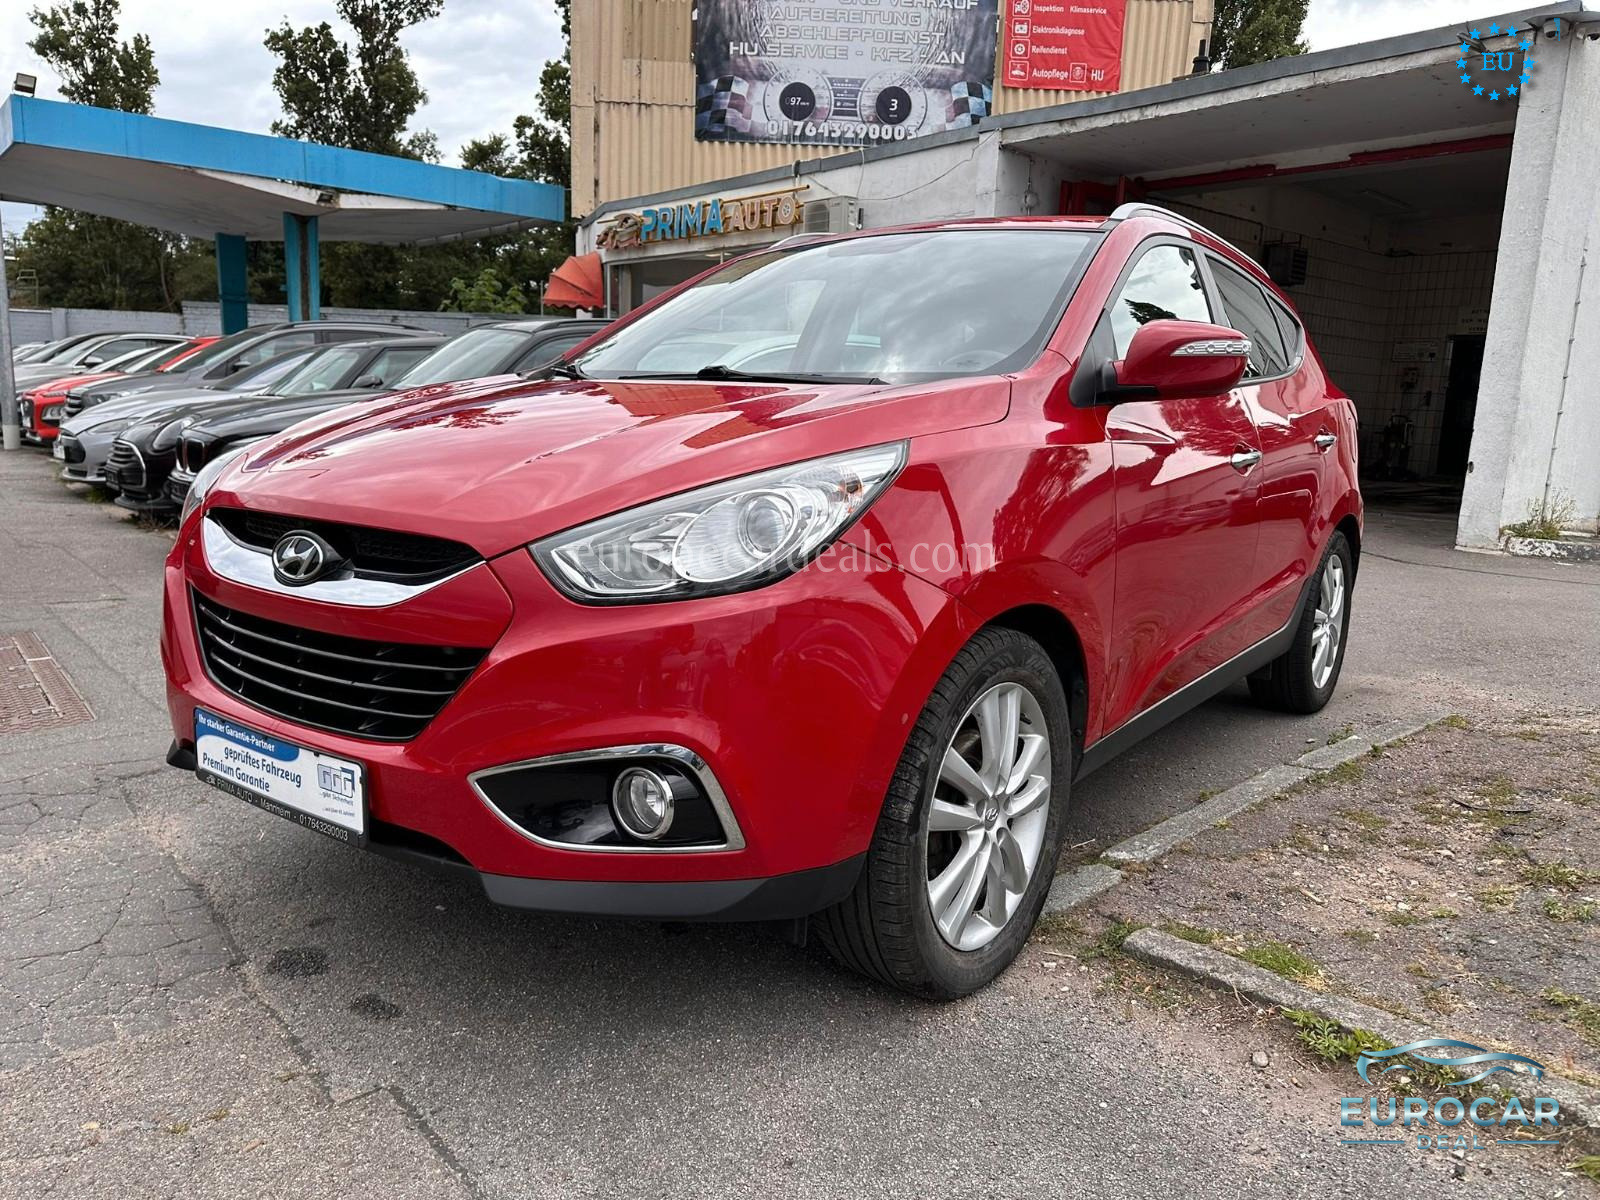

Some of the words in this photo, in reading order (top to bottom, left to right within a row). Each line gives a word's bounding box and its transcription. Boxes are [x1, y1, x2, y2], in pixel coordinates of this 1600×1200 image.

[769, 7, 922, 26] AUFBEREITUNG
[1033, 5, 1065, 14] Inspektion
[1069, 5, 1107, 14] Klimaservice
[760, 25, 945, 45] ABSCHLEPPDIENST
[1032, 26, 1085, 36] Elektronikdiagnose
[729, 41, 759, 56] HU
[766, 43, 849, 60] SERVICE
[871, 46, 913, 63] KFZ
[936, 50, 965, 65] AN
[1031, 45, 1067, 55] Reifendienst
[1031, 68, 1069, 80] Autopflege
[1091, 69, 1105, 81] HU
[766, 119, 918, 140] 017643290003
[640, 198, 724, 242] PRIMA
[729, 194, 796, 231] AUTO
[198, 713, 207, 724] Ihr
[206, 718, 225, 733] starker
[225, 725, 276, 752] Garantie-Partner
[202, 752, 234, 777] Premium
[235, 768, 270, 792] Garantie
[224, 746, 260, 770] geprüftes
[261, 759, 302, 788] Fahrzeug
[216, 778, 236, 797] PRIMA
[236, 788, 253, 804] AUTO
[260, 797, 292, 819] Mannheim
